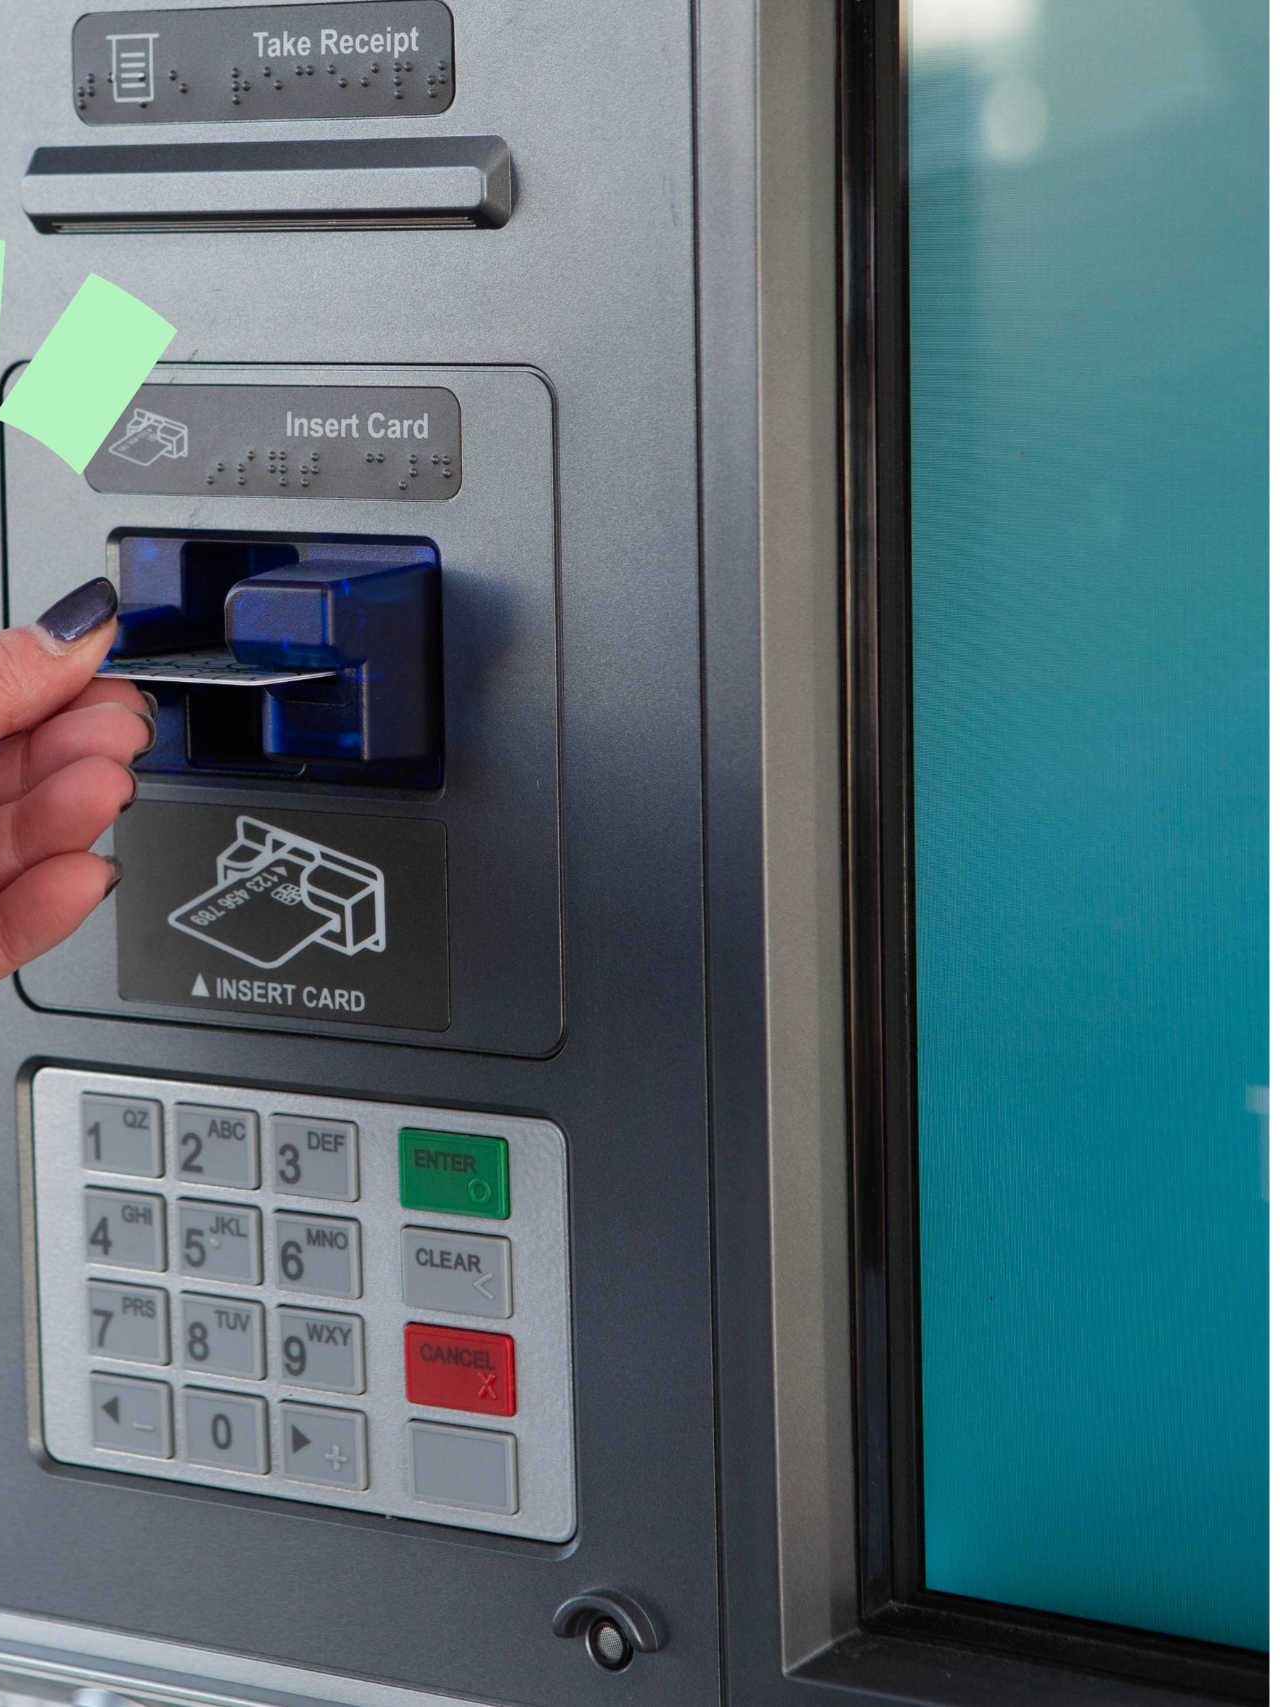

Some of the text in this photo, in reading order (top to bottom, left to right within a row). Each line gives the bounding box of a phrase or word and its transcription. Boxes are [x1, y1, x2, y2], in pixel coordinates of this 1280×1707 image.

[253, 27, 419, 58] Take Receipt
[286, 411, 429, 439] Insert Card
[190, 872, 279, 926] 123 456 789
[216, 977, 366, 1012] INSERT CARD
[123, 1110, 149, 1130] QZ
[207, 1119, 247, 1141] ABC
[87, 1121, 102, 1161] 1
[181, 1133, 204, 1174] 2
[307, 1132, 346, 1153] DEF
[278, 1143, 302, 1185] 3
[414, 1149, 478, 1175] ENTER
[121, 1205, 153, 1226] GHI
[209, 1216, 248, 1238] JKL
[89, 1216, 113, 1256] 4
[184, 1228, 206, 1268] 5
[306, 1228, 348, 1251] MNO
[280, 1240, 304, 1282] 6
[415, 1248, 482, 1274] CLEAR
[122, 1296, 156, 1319] PRS
[214, 1309, 251, 1332] TUV
[91, 1309, 114, 1348] 7
[187, 1321, 210, 1362] 8
[305, 1322, 352, 1346] WXY
[283, 1335, 306, 1377] 9
[420, 1342, 496, 1371] CANCEL
[211, 1413, 232, 1450] 0
